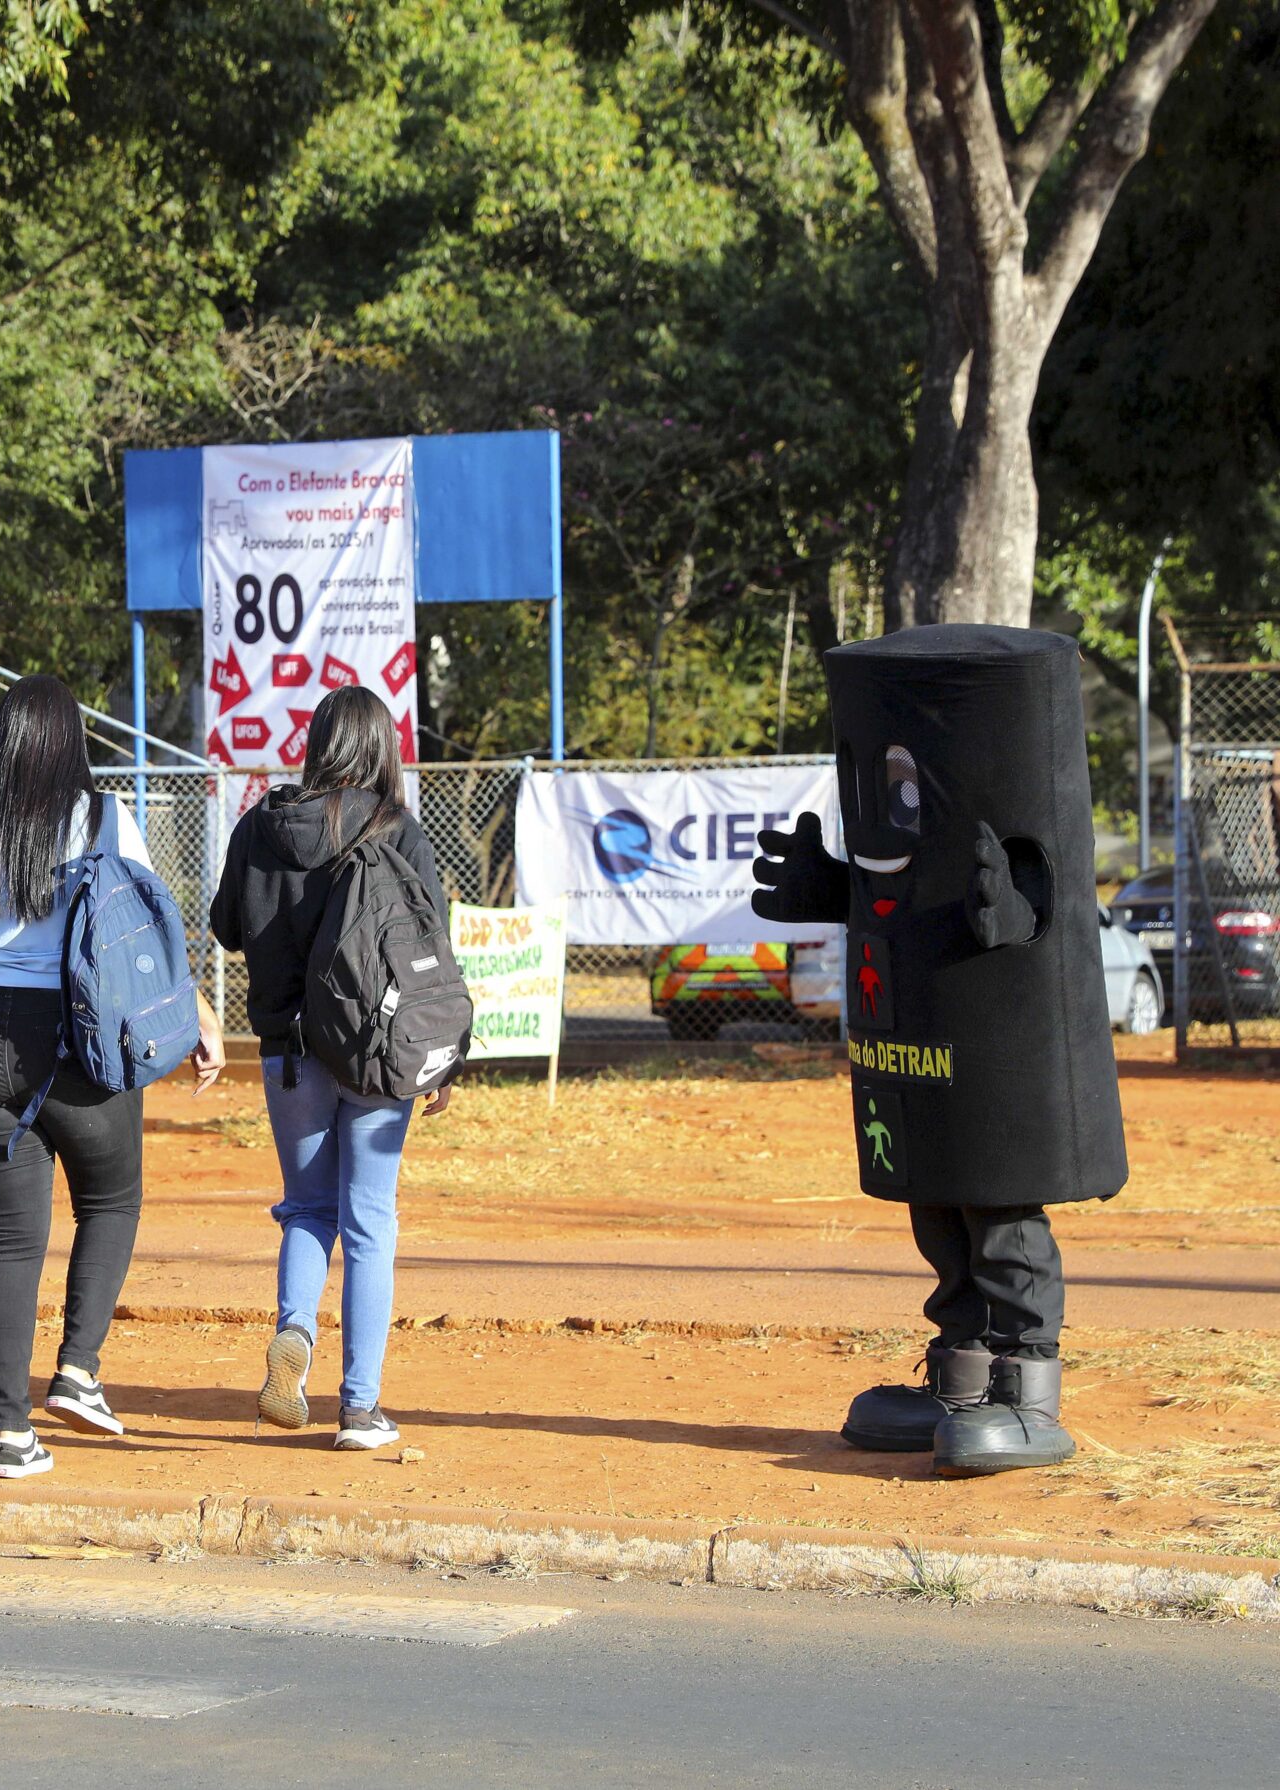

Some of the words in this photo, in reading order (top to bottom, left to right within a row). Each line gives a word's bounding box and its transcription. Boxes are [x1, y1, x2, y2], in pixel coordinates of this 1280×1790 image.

[238, 473, 272, 493] Com
[276, 478, 285, 491] o
[290, 471, 347, 492] Elefante
[352, 470, 406, 489] Branco
[286, 509, 314, 522] vou
[319, 502, 355, 521] mais
[358, 498, 406, 525] longe!
[234, 573, 304, 644] 80
[862, 1039, 876, 1069] do
[877, 1041, 951, 1078] DETRAN
